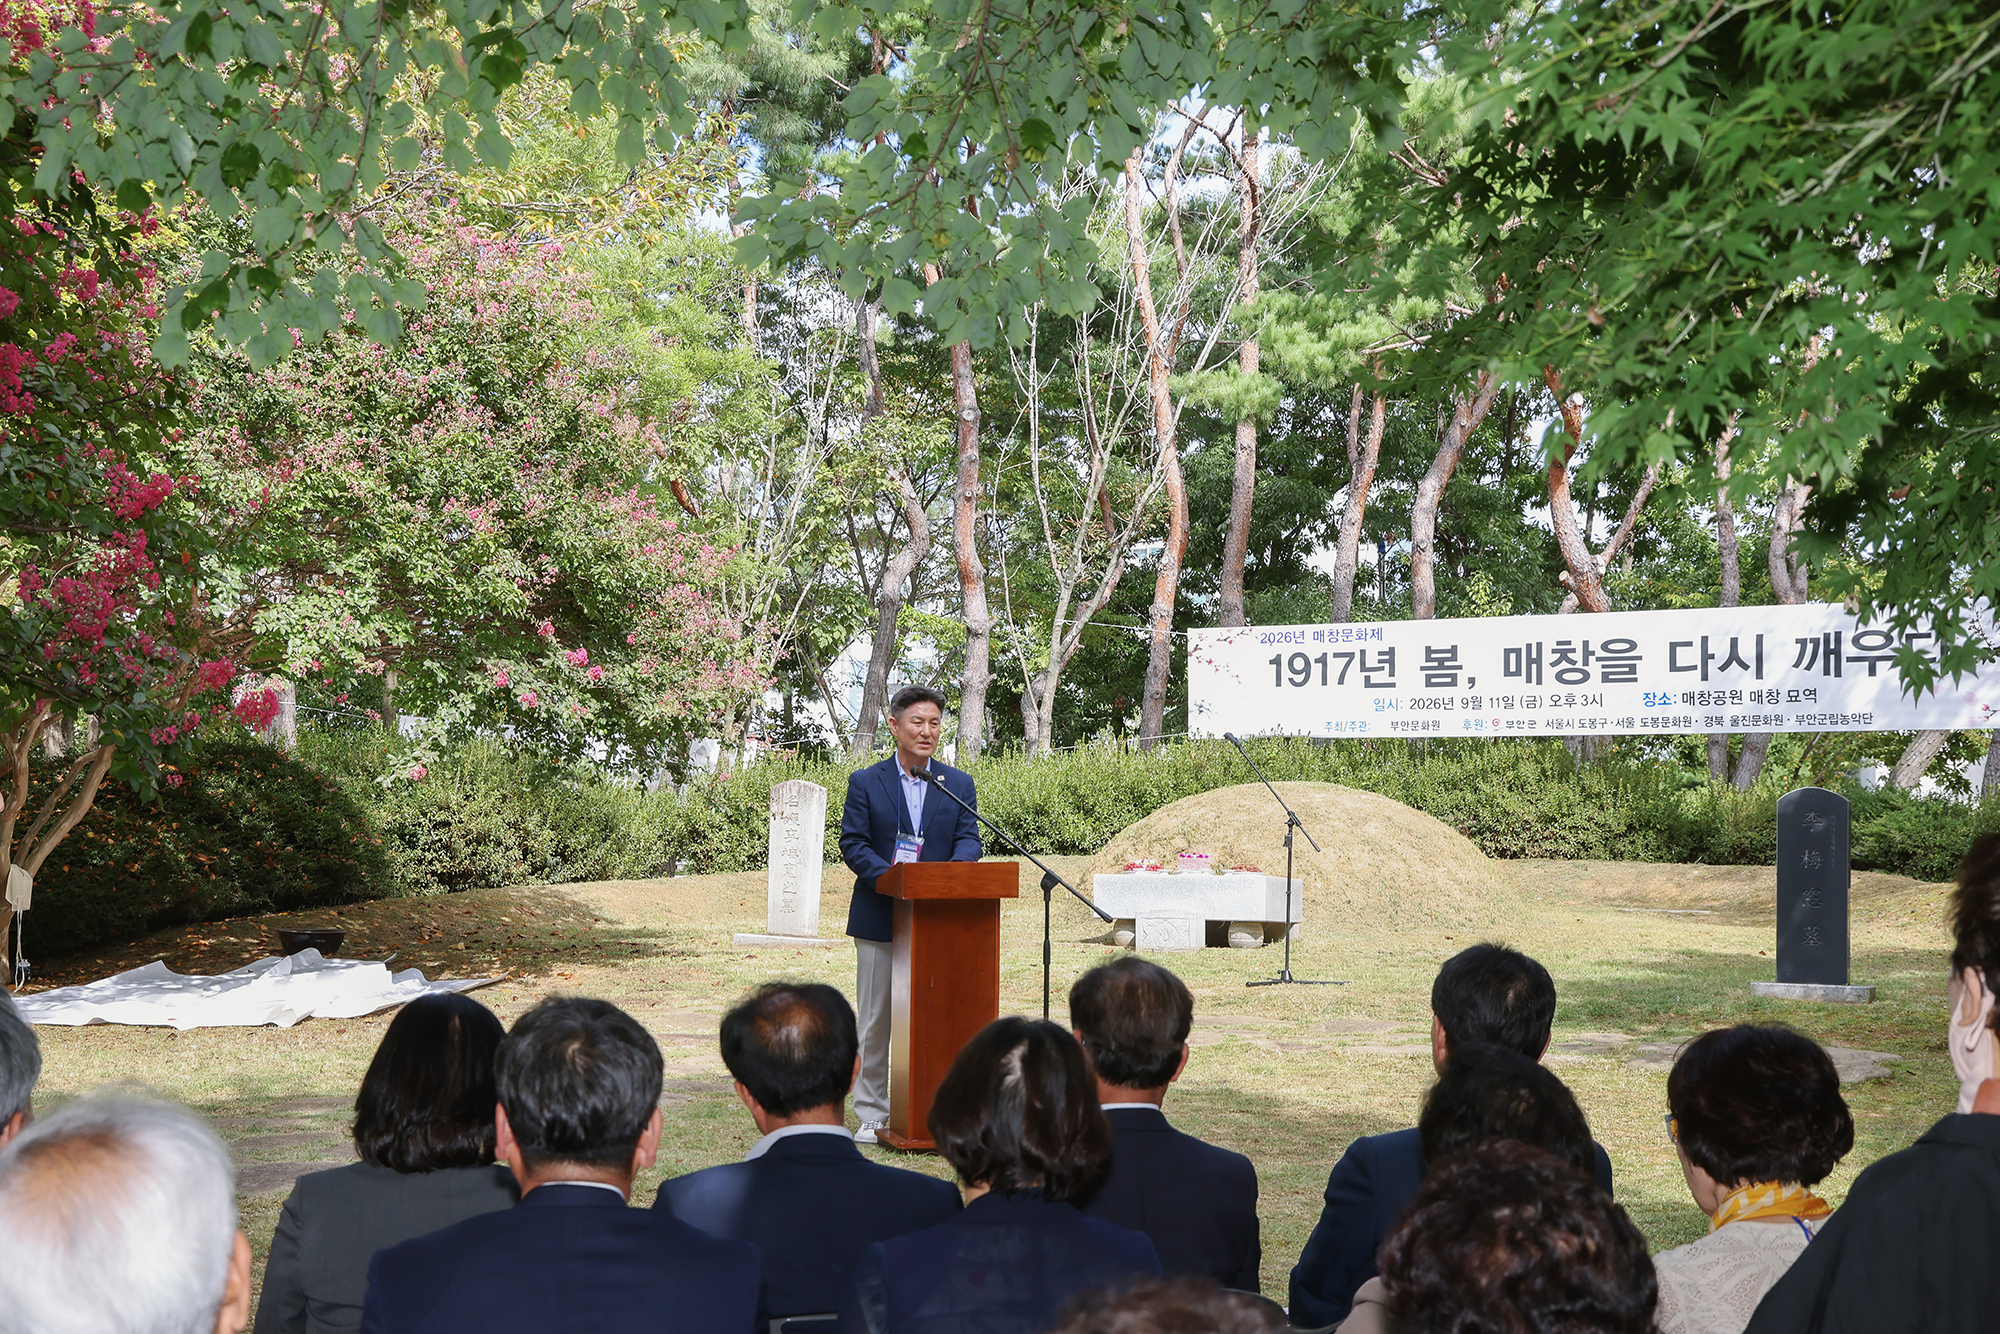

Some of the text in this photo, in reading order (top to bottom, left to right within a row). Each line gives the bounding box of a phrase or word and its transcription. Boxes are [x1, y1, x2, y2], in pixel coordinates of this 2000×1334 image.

[1260, 627, 1383, 645] 2026년 매창문화제
[1268, 647, 1397, 689] 1917년
[1419, 644, 1476, 690] 봄,
[1503, 637, 1643, 686] 매창을
[1668, 633, 1765, 682] 다시
[1373, 687, 1818, 712] 일시: 2026년 9월 11일 (금) 오후 3시 장소: 매창공원 매창 묘역
[1324, 720, 1371, 733] 주최/주관:
[1390, 719, 1441, 732] 부안문화원
[1462, 718, 1488, 731] 후원:
[1505, 719, 1537, 730] 부안군
[1544, 718, 1575, 730] 서울시
[1703, 715, 1725, 728] 경북
[1794, 712, 1874, 727] 부안군립농악단
